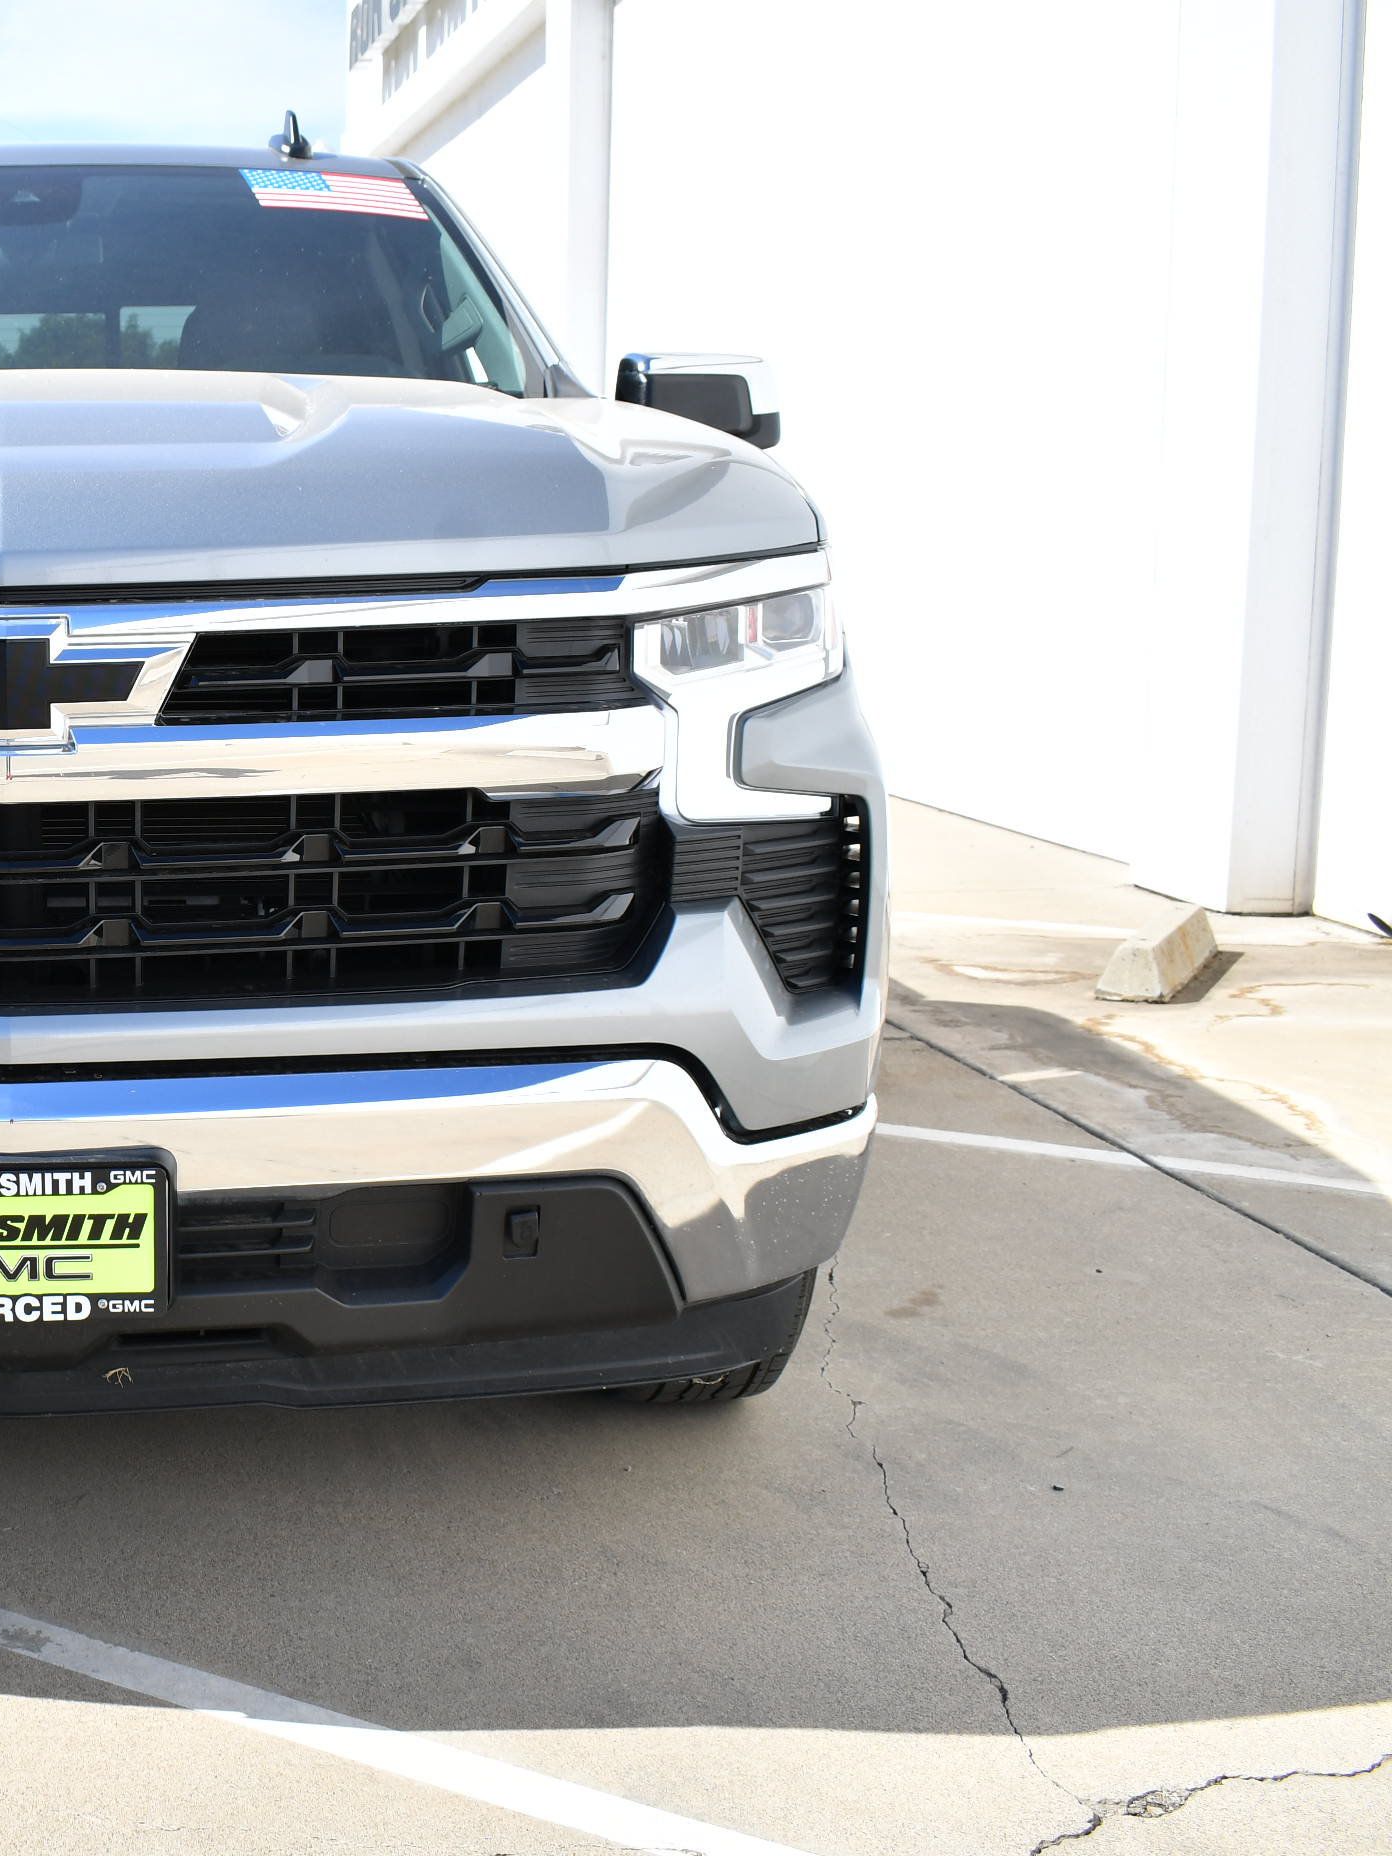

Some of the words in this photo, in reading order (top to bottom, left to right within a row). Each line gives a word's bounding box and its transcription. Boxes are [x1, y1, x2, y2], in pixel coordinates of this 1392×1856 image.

[0, 1172, 92, 1196] SMITH
[109, 1170, 156, 1184] GMC
[109, 1299, 155, 1313] GMC
